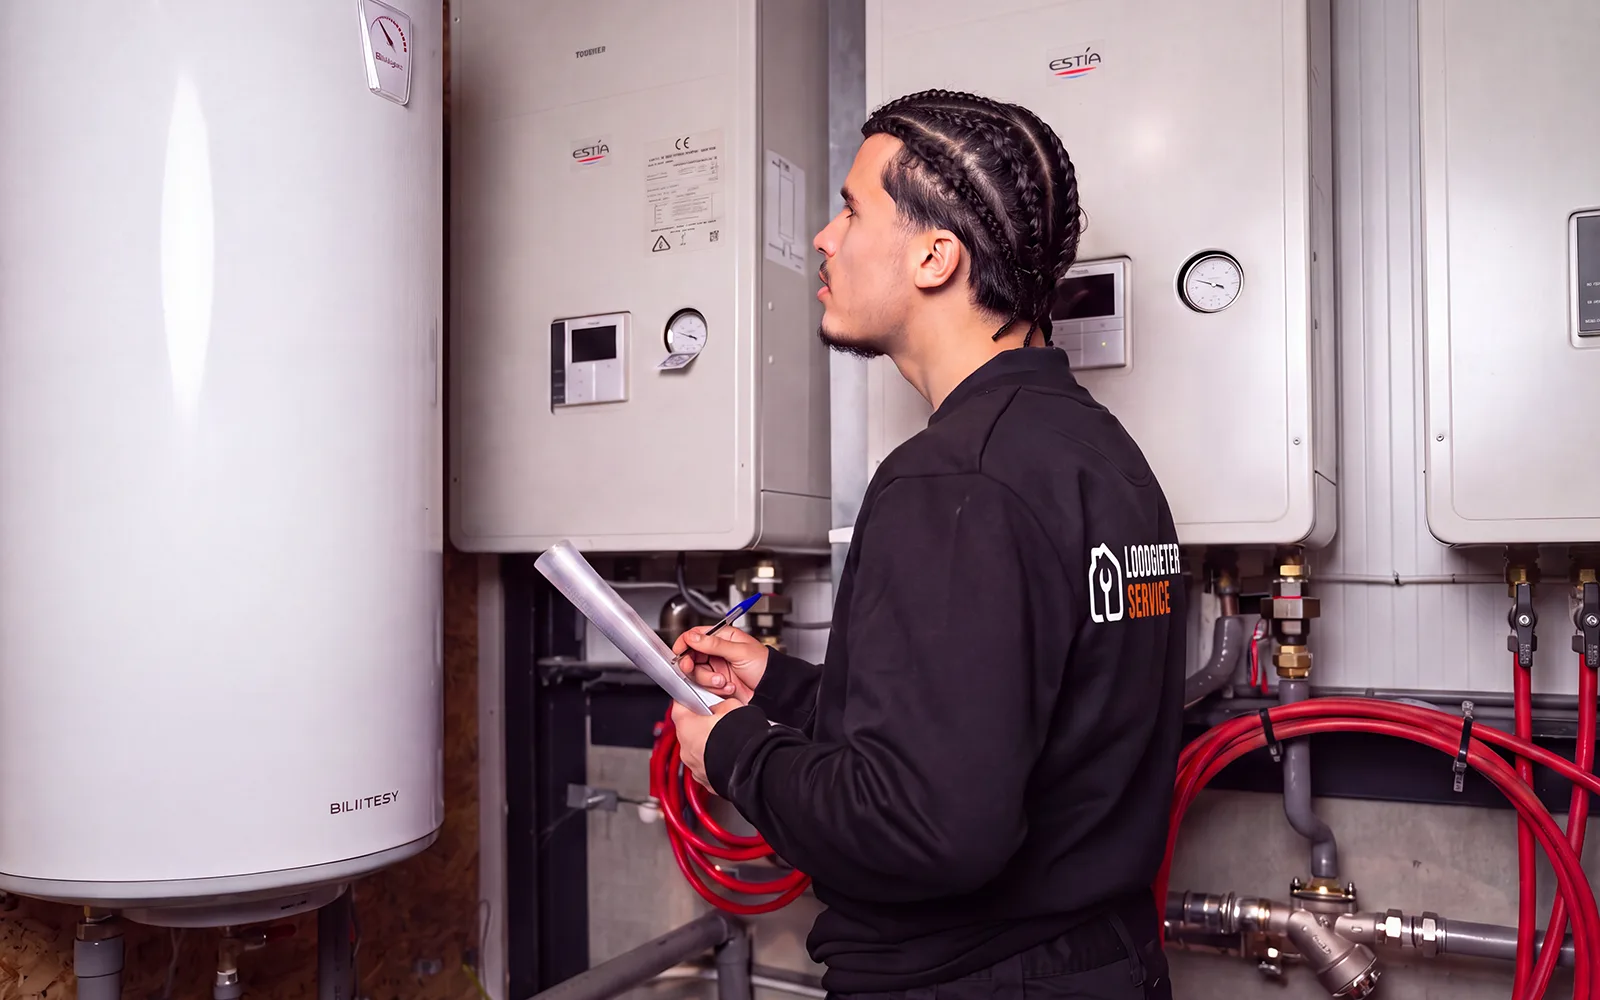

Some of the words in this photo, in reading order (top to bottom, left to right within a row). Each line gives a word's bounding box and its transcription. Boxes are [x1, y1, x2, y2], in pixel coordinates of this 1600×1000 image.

[1048, 46, 1102, 71] ESTÍA
[1123, 543, 1181, 578] LOODGIETER
[1127, 580, 1171, 619] SERVICE
